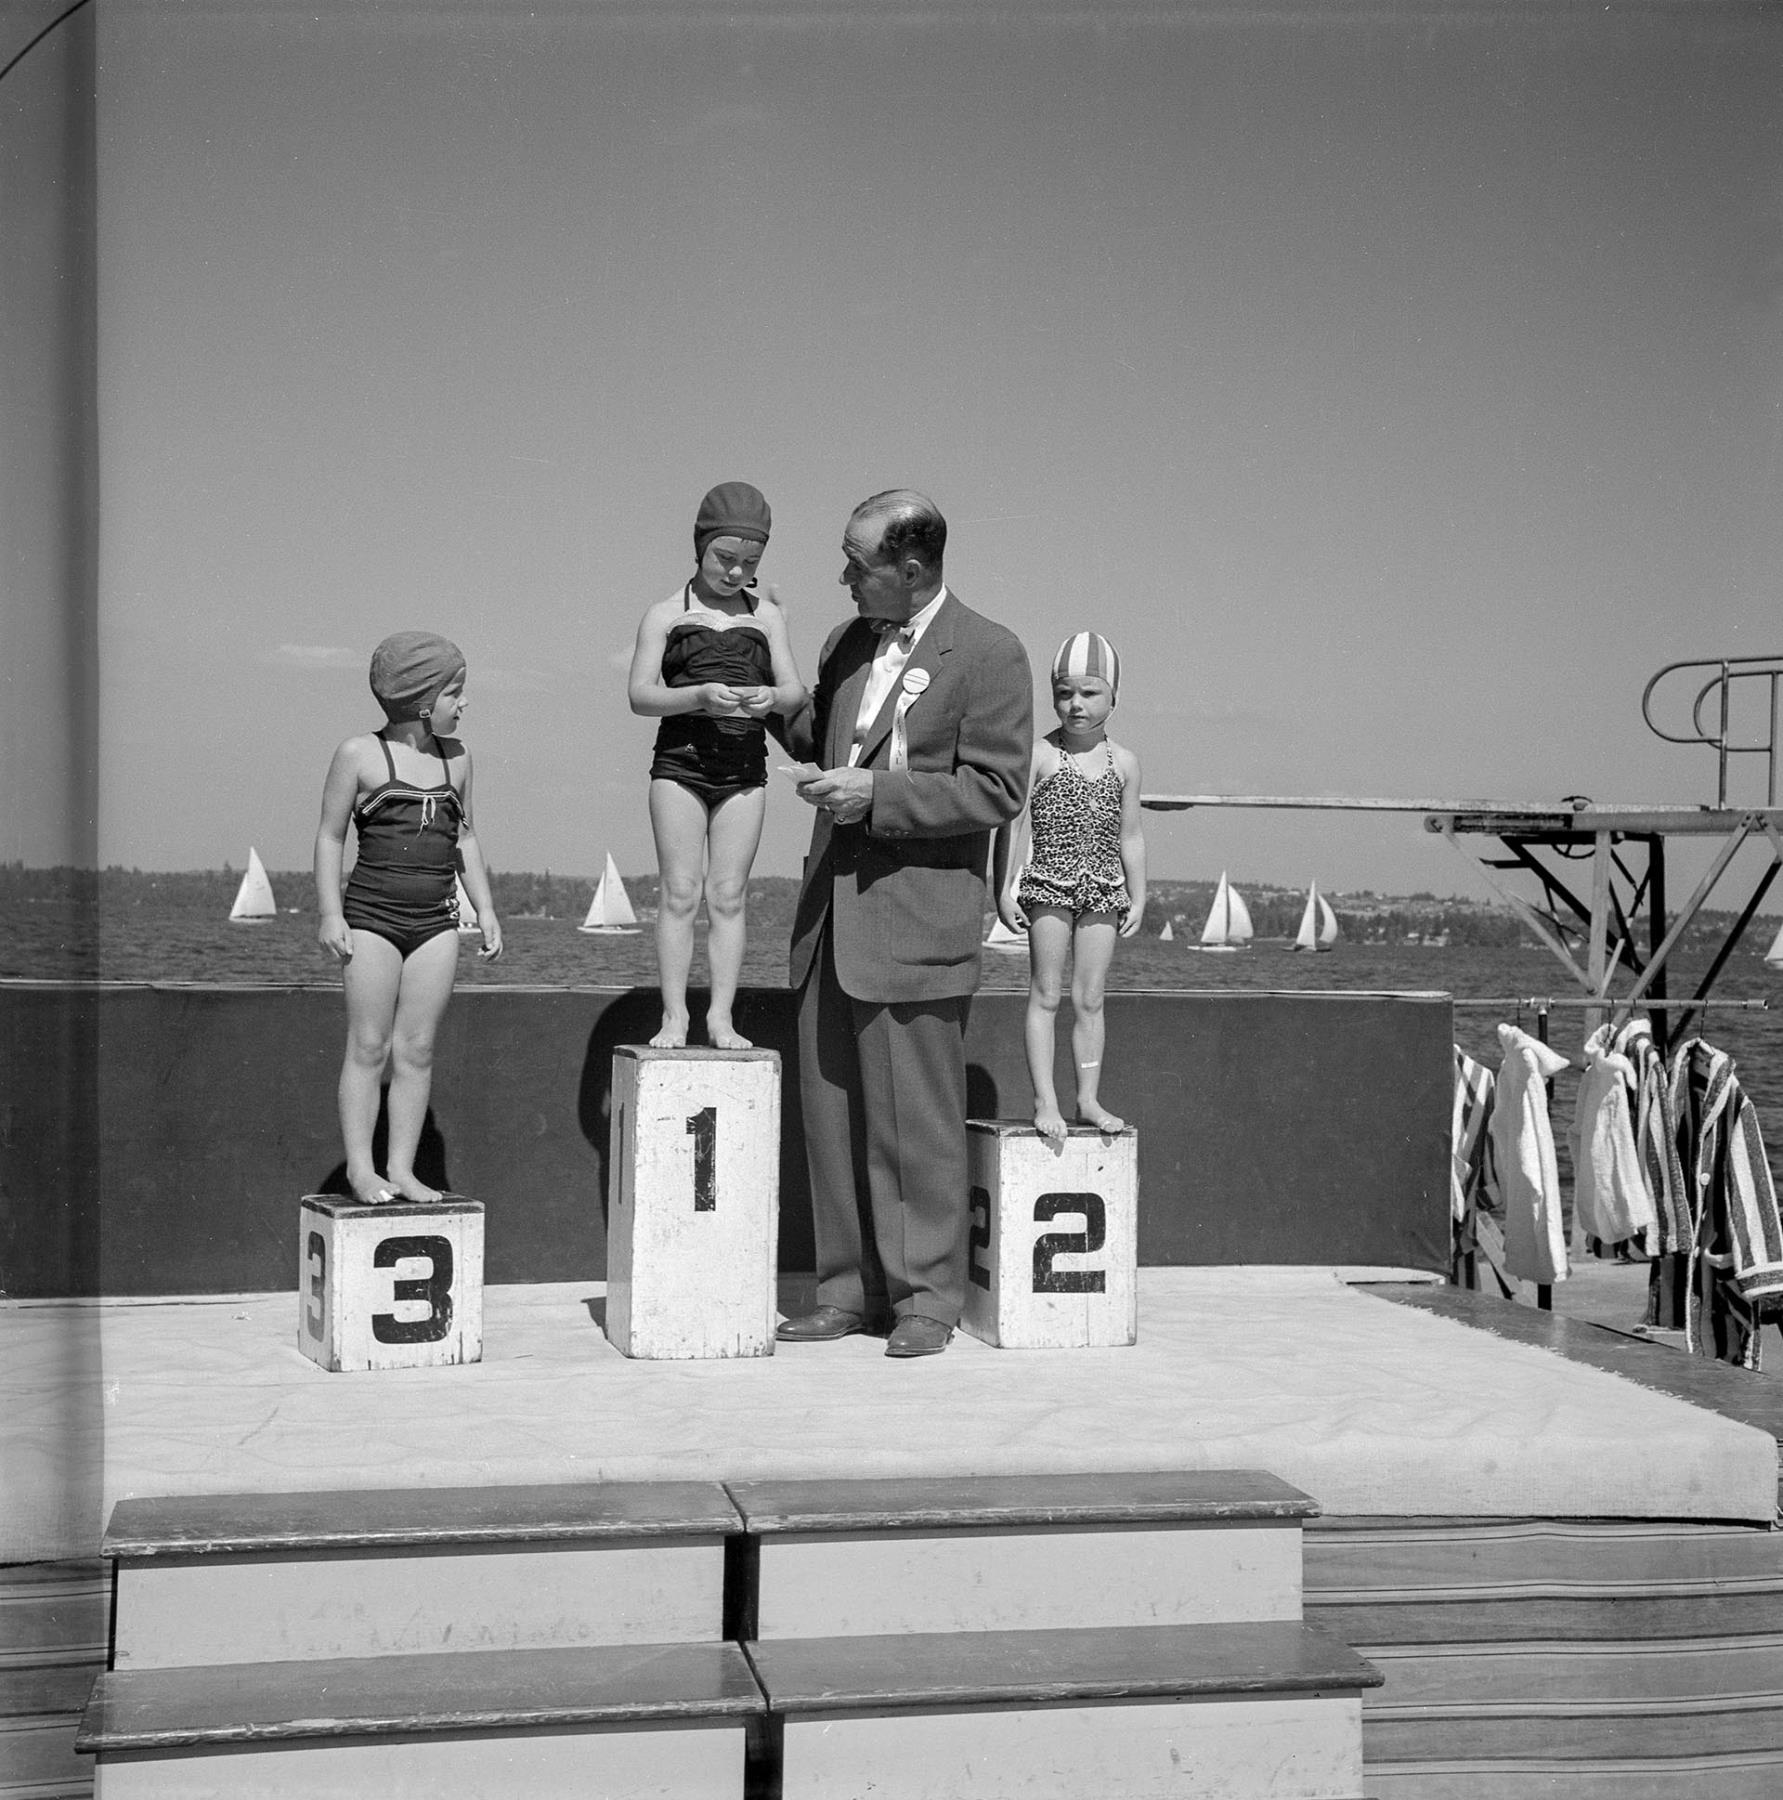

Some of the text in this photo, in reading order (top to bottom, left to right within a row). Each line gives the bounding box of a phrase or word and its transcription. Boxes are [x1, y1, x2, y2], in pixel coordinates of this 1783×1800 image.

[686, 1107, 717, 1211] 1
[307, 1230, 325, 1342] 3
[372, 1235, 454, 1344] 3
[969, 1185, 991, 1291] 2
[1032, 1192, 1106, 1293] 2
